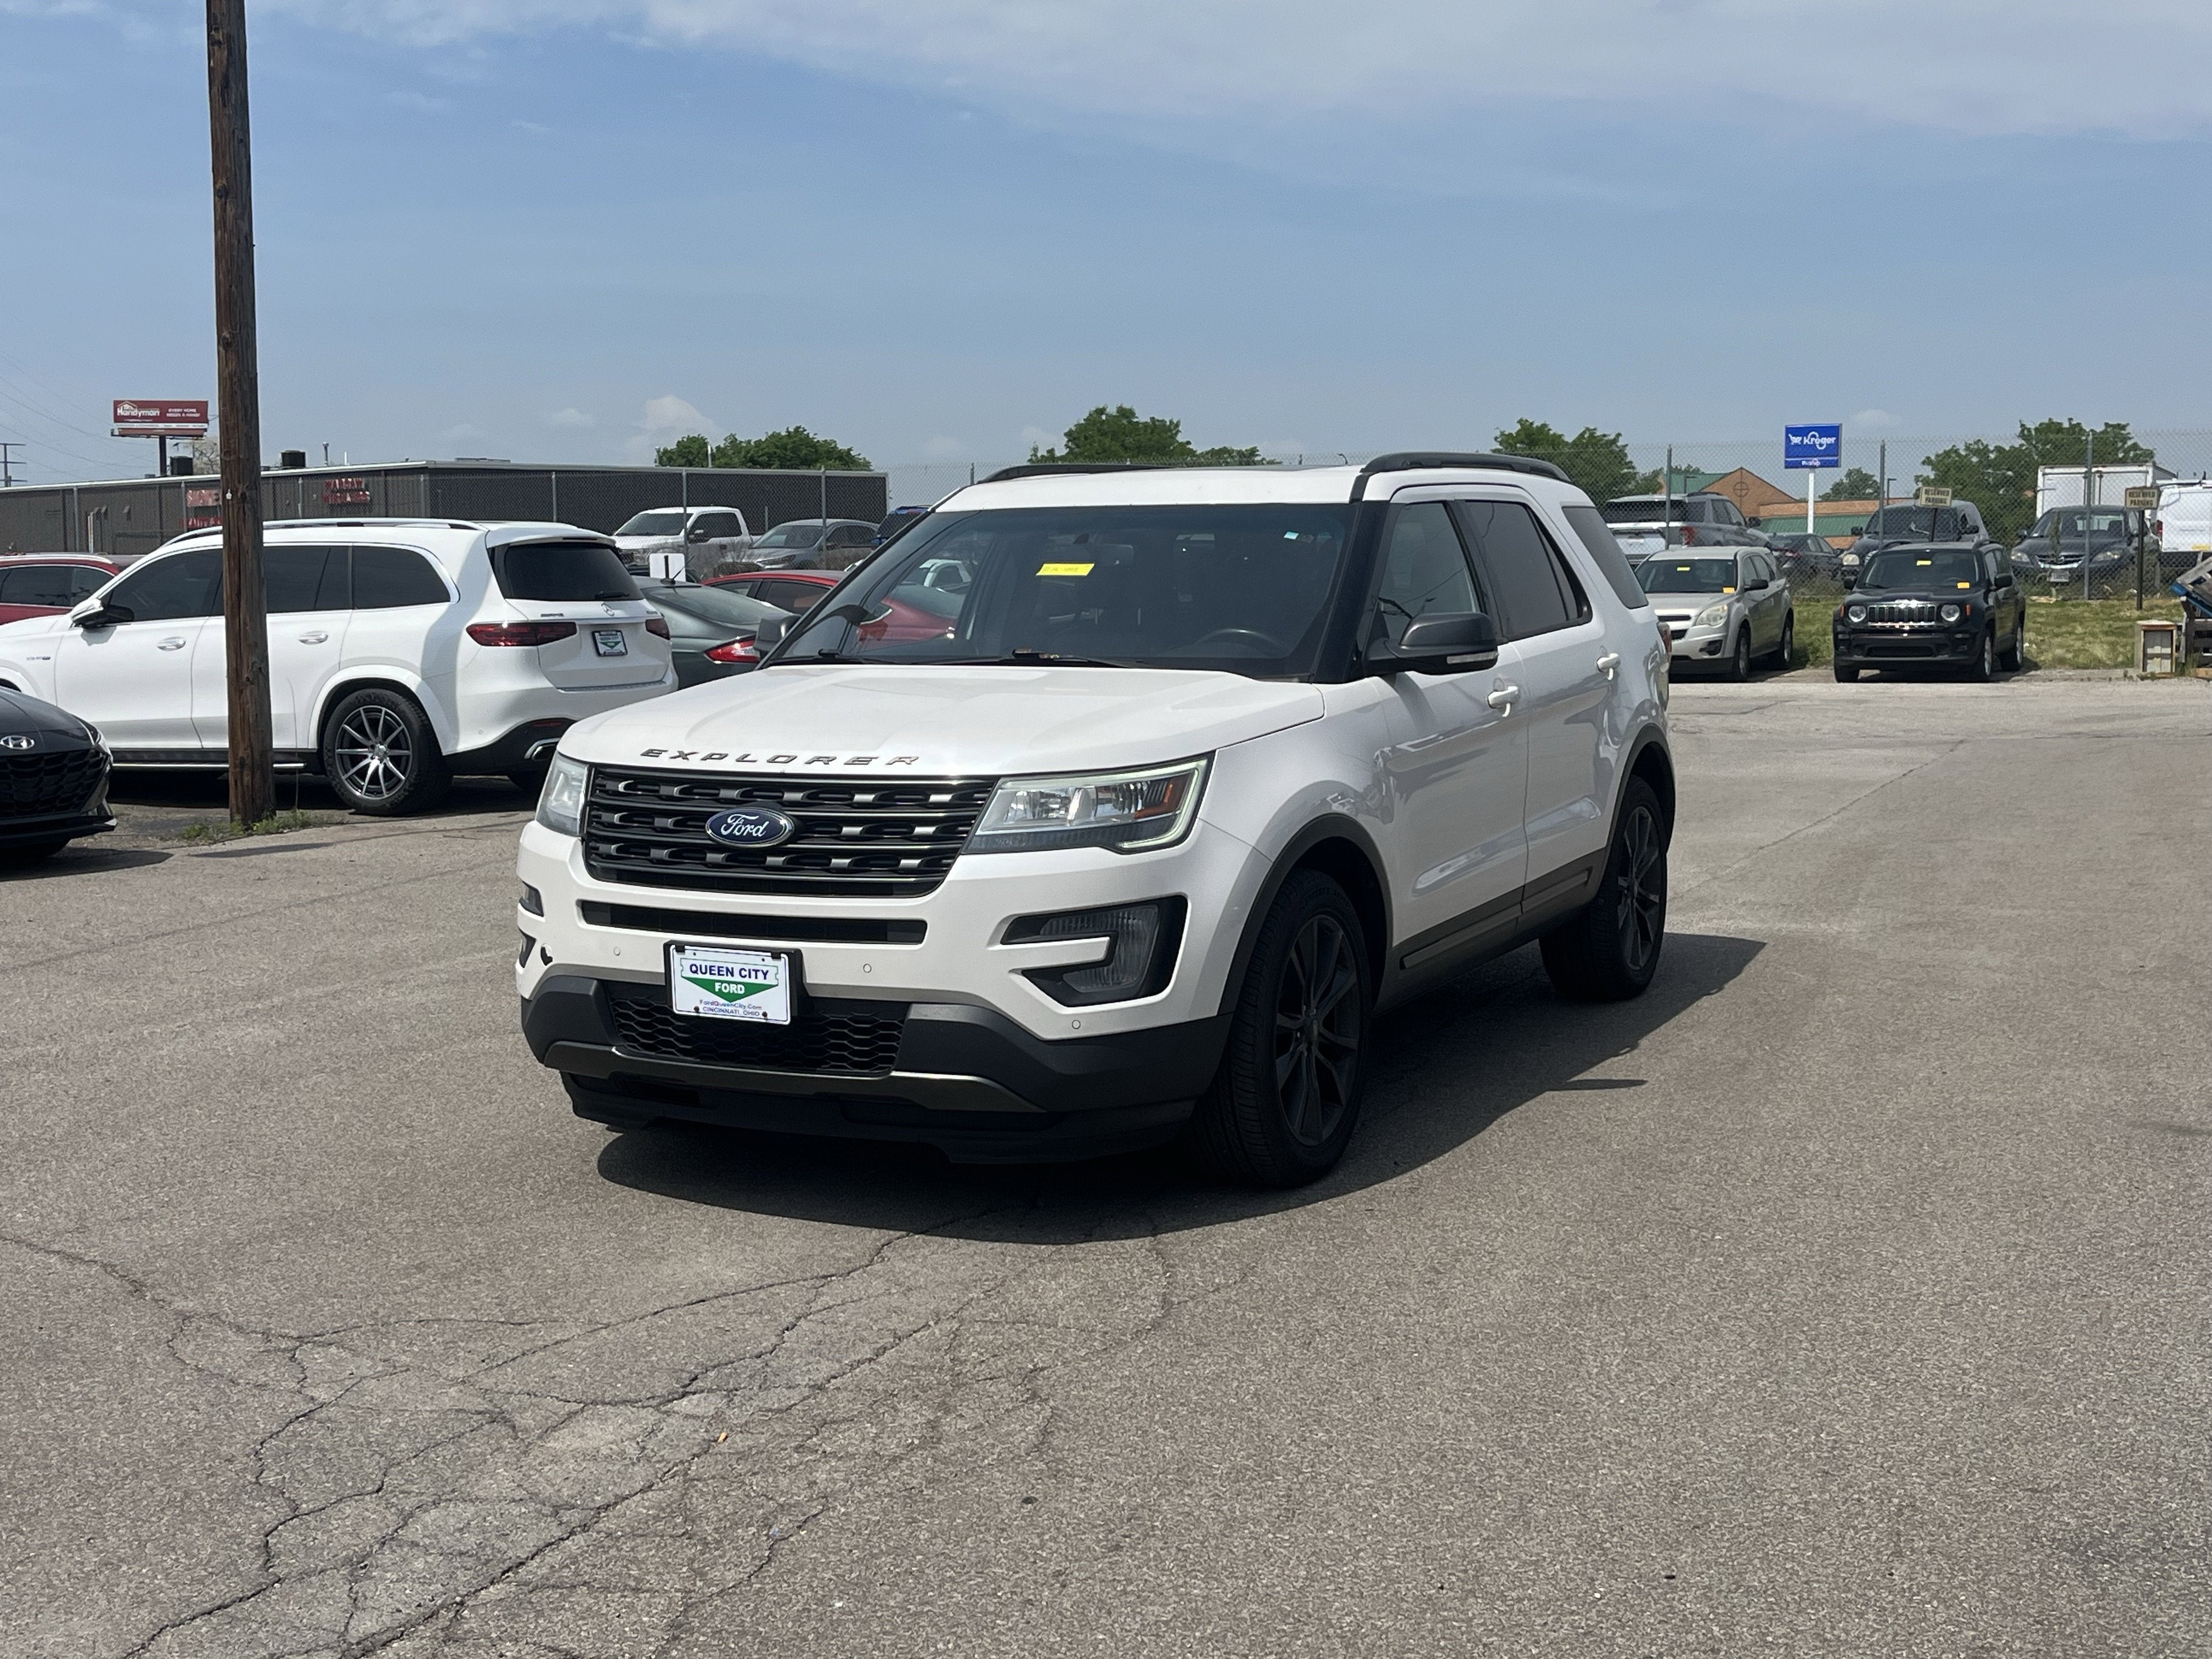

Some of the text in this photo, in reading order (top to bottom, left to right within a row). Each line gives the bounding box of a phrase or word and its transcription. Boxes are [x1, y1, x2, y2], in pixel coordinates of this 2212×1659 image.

[117, 407, 160, 417] Handyman
[1803, 431, 1837, 450] Kroger
[1924, 488, 1950, 496] RESERVED
[1925, 496, 1948, 504] PARKING
[640, 748, 919, 765] EXPLORER
[721, 814, 769, 837] Ford
[690, 963, 769, 980] QUEEN CITY
[714, 982, 745, 994] FORD
